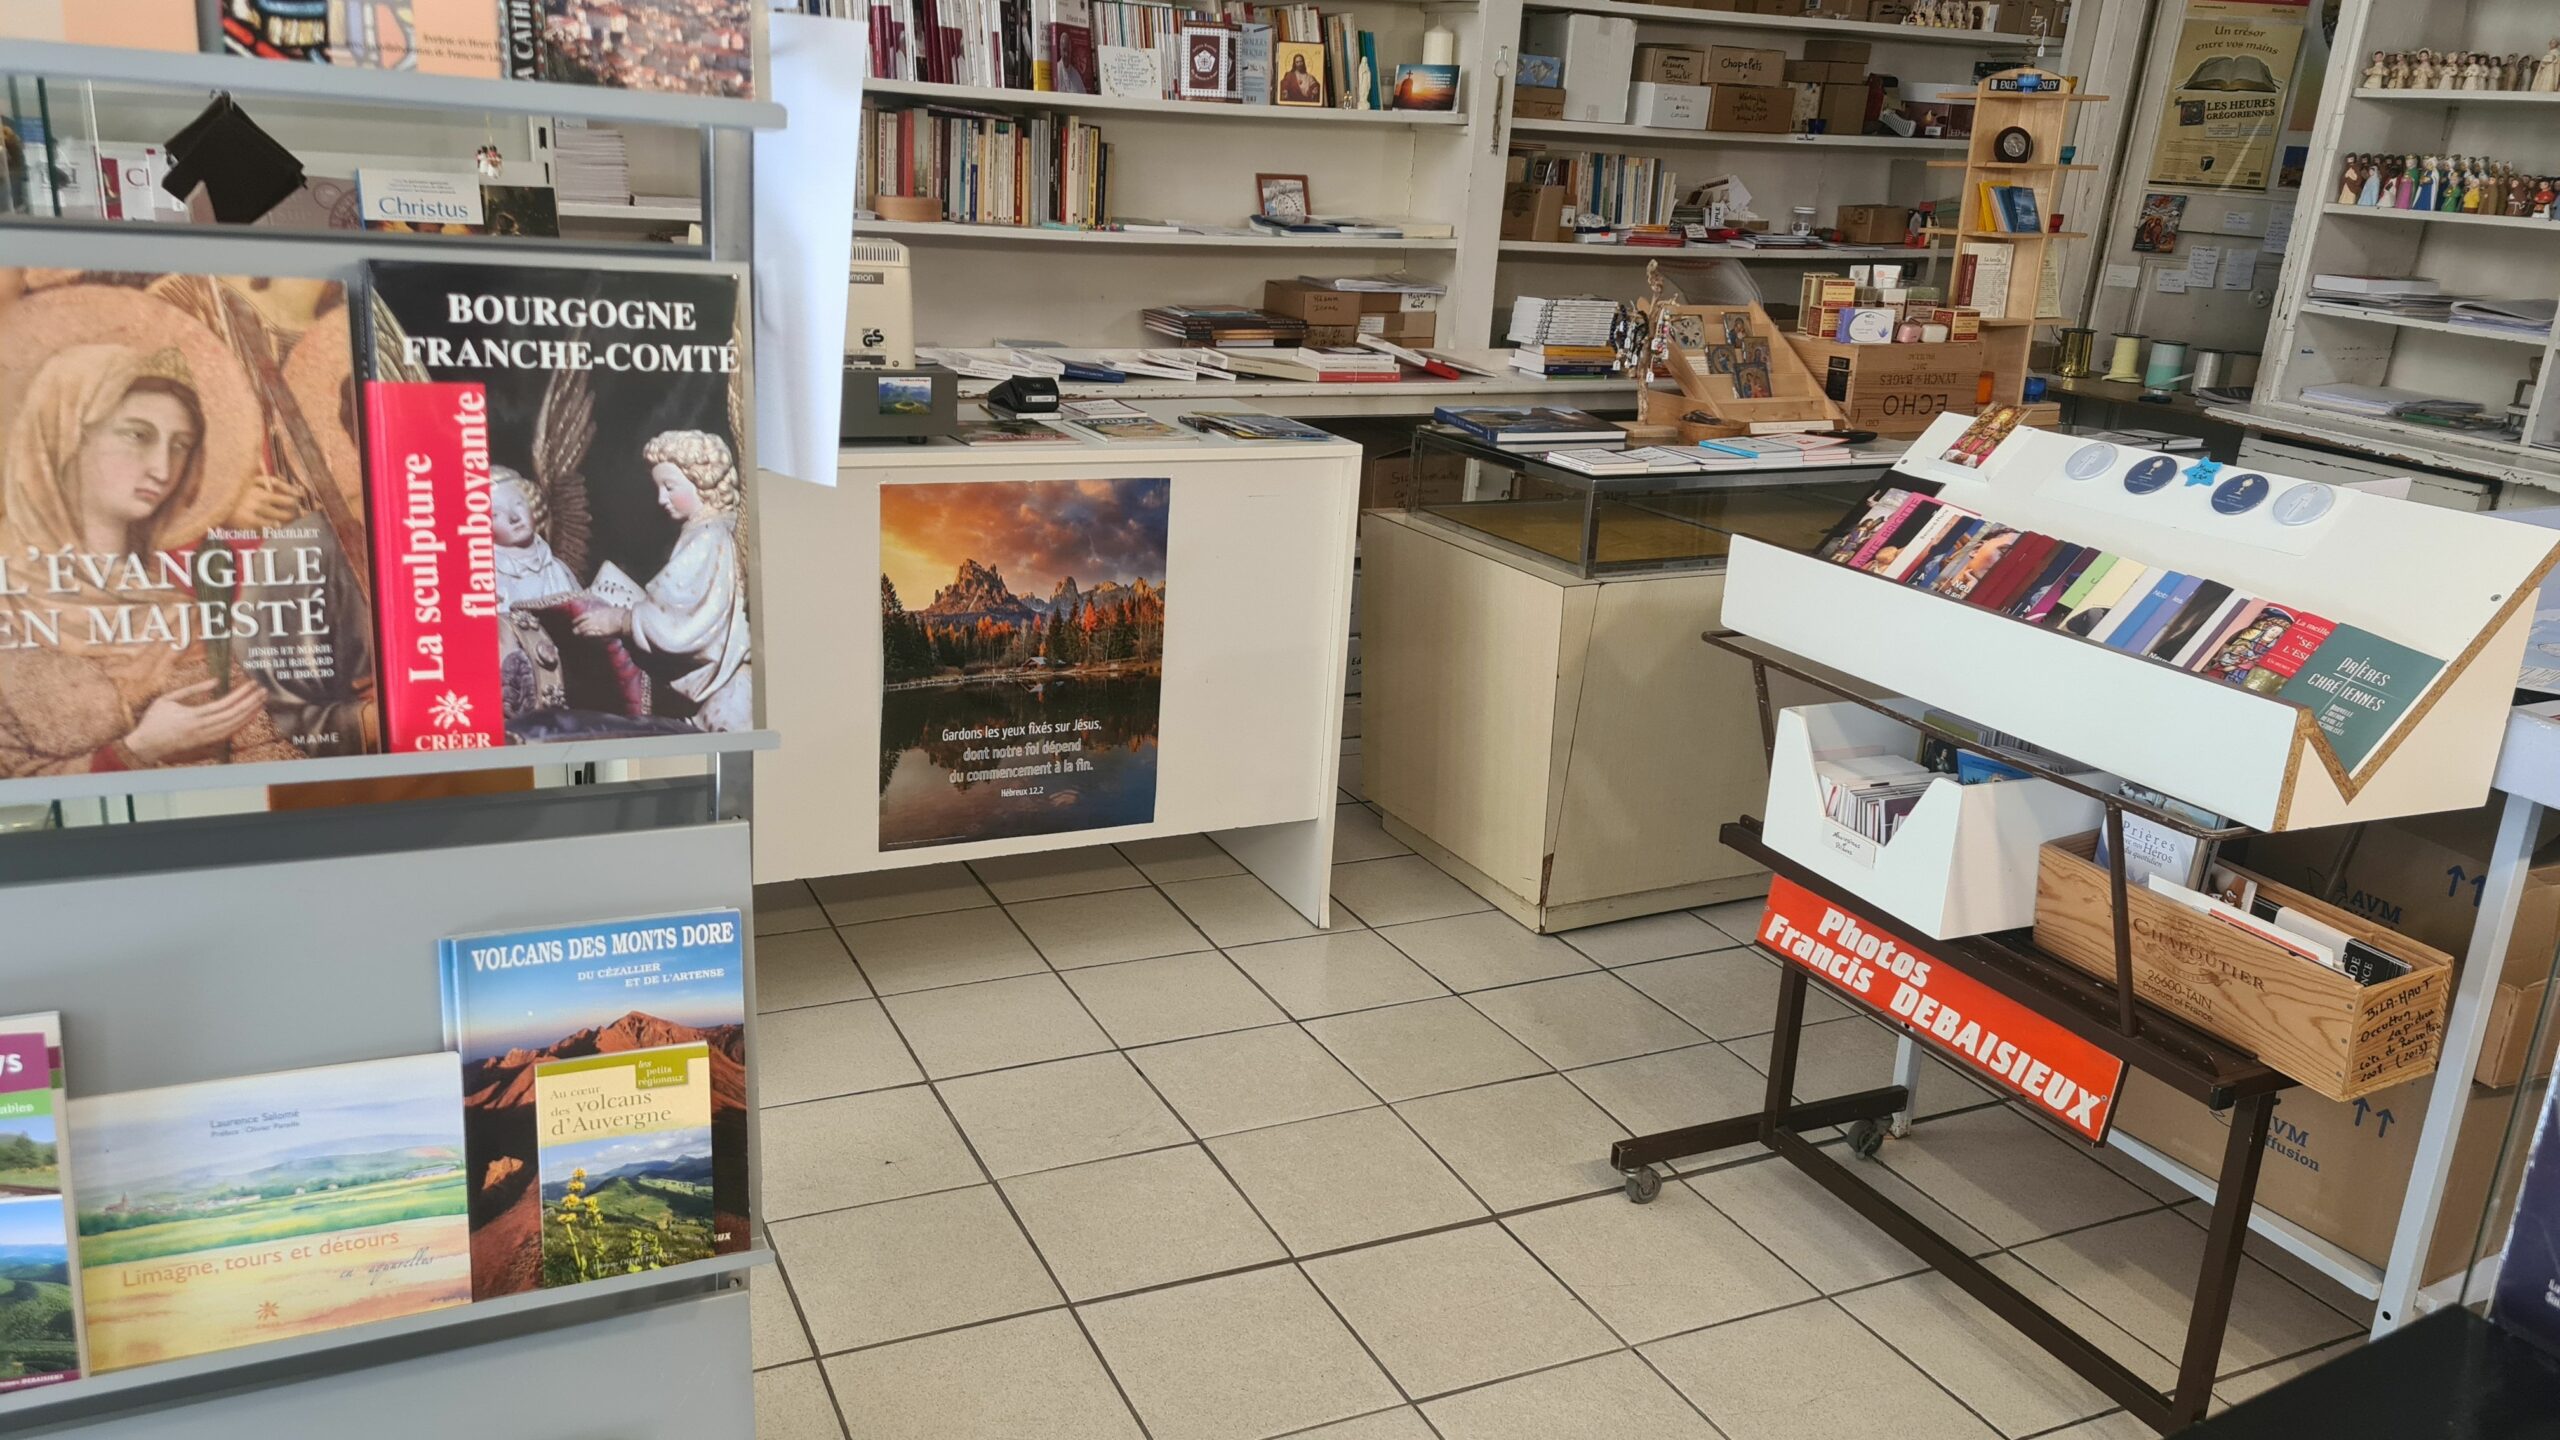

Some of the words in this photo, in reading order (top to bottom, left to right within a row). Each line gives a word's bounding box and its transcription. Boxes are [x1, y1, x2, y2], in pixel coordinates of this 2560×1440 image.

[2214, 26, 2231, 36] Un
[2234, 28, 2266, 38] trésor
[2195, 40, 2223, 51] entre
[2226, 41, 2243, 49] vos
[2246, 42, 2279, 55] mains
[2206, 109, 2275, 120] GRÉGORIENNES
[2207, 101, 2227, 111] LES
[2229, 98, 2276, 110] HEURES
[379, 197, 469, 219] Christus
[447, 293, 696, 331] BOURGOGNE
[402, 336, 740, 374] FRANCHE-COMTÉ
[1880, 374, 1913, 386] BAGES
[1923, 372, 1957, 385] LYNCH
[1882, 393, 1948, 416] ECHO
[453, 391, 497, 619] flamboyante
[401, 453, 447, 624] sculpture
[0, 544, 327, 596] L'ÉVANGILE
[87, 587, 331, 651] MAJESTÉ
[2295, 618, 2306, 627] La
[409, 633, 445, 683] La
[2336, 656, 2391, 687] PRIÈRES
[292, 732, 340, 745] MAME
[415, 730, 492, 751] CRÉER
[942, 727, 983, 742] Gardons
[985, 725, 1000, 739] les
[1001, 726, 1026, 741] yeux
[1028, 721, 1053, 736] fixés
[1055, 722, 1069, 733] sur
[1072, 718, 1102, 732] Jésus,
[963, 748, 989, 762] dont
[992, 745, 1023, 759] notre
[1025, 741, 1040, 756] foi
[1042, 738, 1082, 756] dépend
[949, 770, 965, 784] du
[966, 764, 1053, 783] commencement
[1054, 761, 1062, 773] à
[1063, 760, 1074, 773] la
[1076, 758, 1093, 772] fin.
[1000, 787, 1028, 798] Hébreux
[2123, 820, 2176, 852] Prières
[2131, 851, 2163, 868] quotidien
[2143, 842, 2173, 864] Héros
[2350, 889, 2403, 925] AVM
[471, 943, 563, 973] VOLCANS
[568, 935, 607, 961] DES
[612, 927, 678, 957] MONTS
[682, 921, 734, 947] DORE
[1817, 906, 1932, 989] Photos
[2133, 917, 2266, 993] CHAPOUTIER
[577, 970, 594, 981] DU
[597, 962, 661, 980] CÉZALLIER
[625, 976, 641, 988] ET
[643, 974, 660, 986] DE
[662, 968, 725, 984] L'ARTENSE
[2349, 956, 2362, 981] DE
[2142, 980, 2174, 1003] Product
[2174, 996, 2183, 1006] of
[2184, 1000, 2214, 1022] France
[2147, 968, 2213, 1011] 26600-TAIN
[1763, 912, 1875, 994] Francis
[1888, 981, 2102, 1130] DEBAISIEUX
[638, 1059, 652, 1068] les
[646, 1066, 673, 1077] petits
[550, 1090, 567, 1101] Au
[570, 1086, 601, 1099] cœur
[550, 1105, 571, 1117] des
[576, 1092, 653, 1114] volcans
[208, 1117, 260, 1129] Laurence
[550, 1106, 673, 1137] d'Auvergne
[2268, 1115, 2310, 1148] VM
[123, 1262, 219, 1288] Limagne,
[225, 1249, 283, 1272] tours
[290, 1246, 312, 1261] et
[319, 1231, 401, 1256] détours
[339, 1268, 354, 1280] en
[367, 1246, 435, 1287] aquarelles
